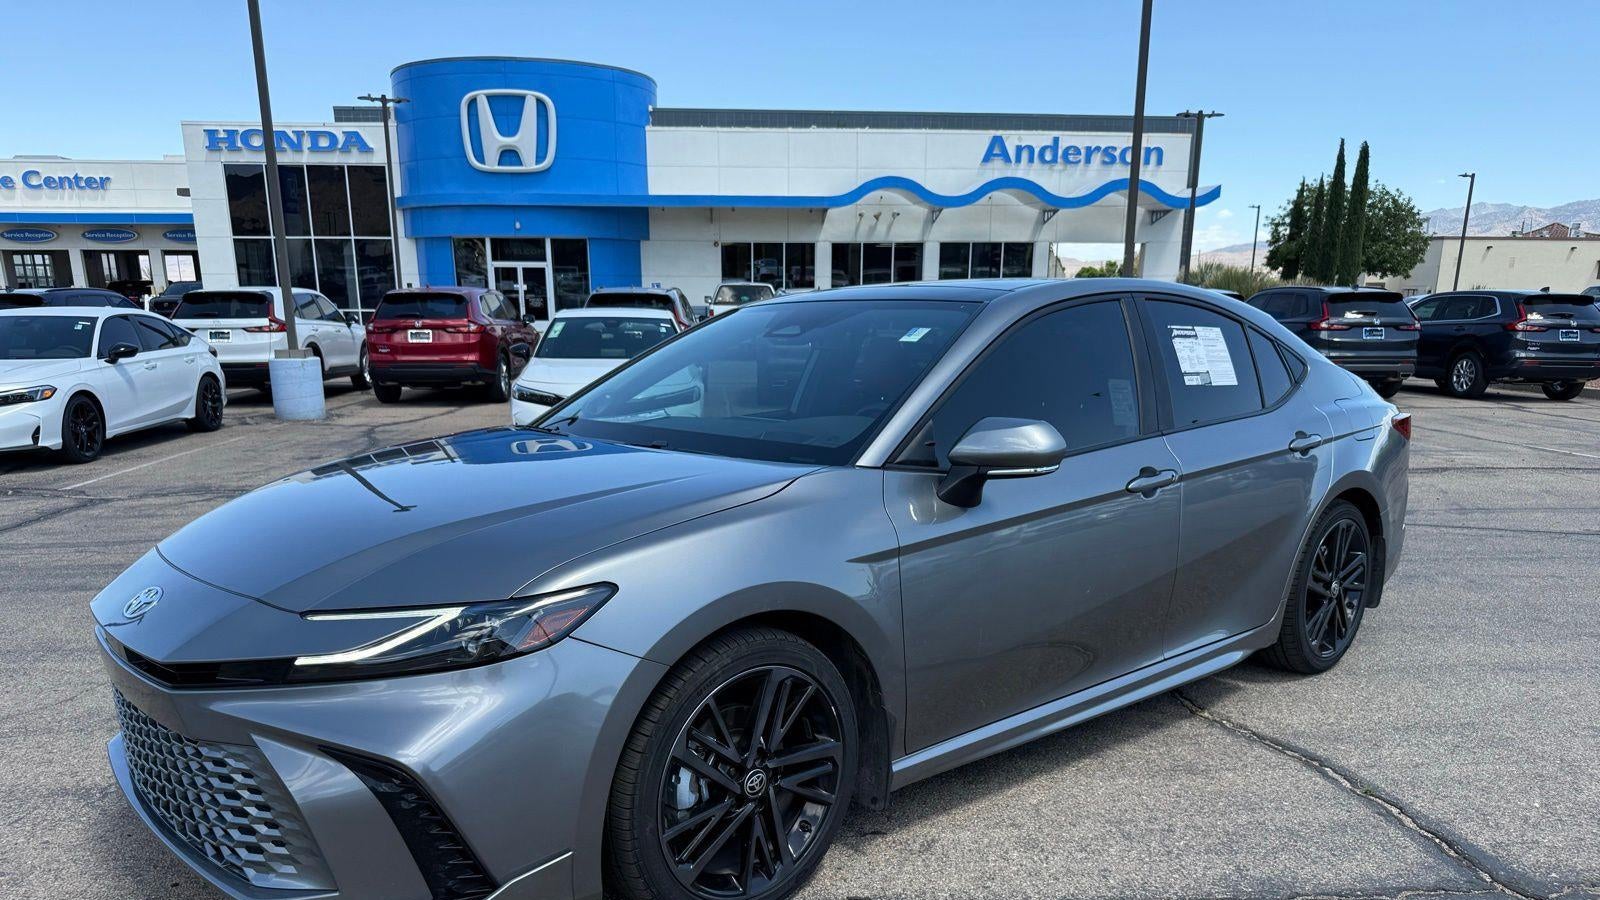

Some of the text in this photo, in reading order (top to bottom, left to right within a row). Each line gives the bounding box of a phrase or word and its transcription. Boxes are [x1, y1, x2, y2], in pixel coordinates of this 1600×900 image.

[203, 128, 375, 152] HONDA
[981, 135, 1165, 167] Anderson
[21, 169, 111, 191] Center
[106, 232, 134, 240] Reception
